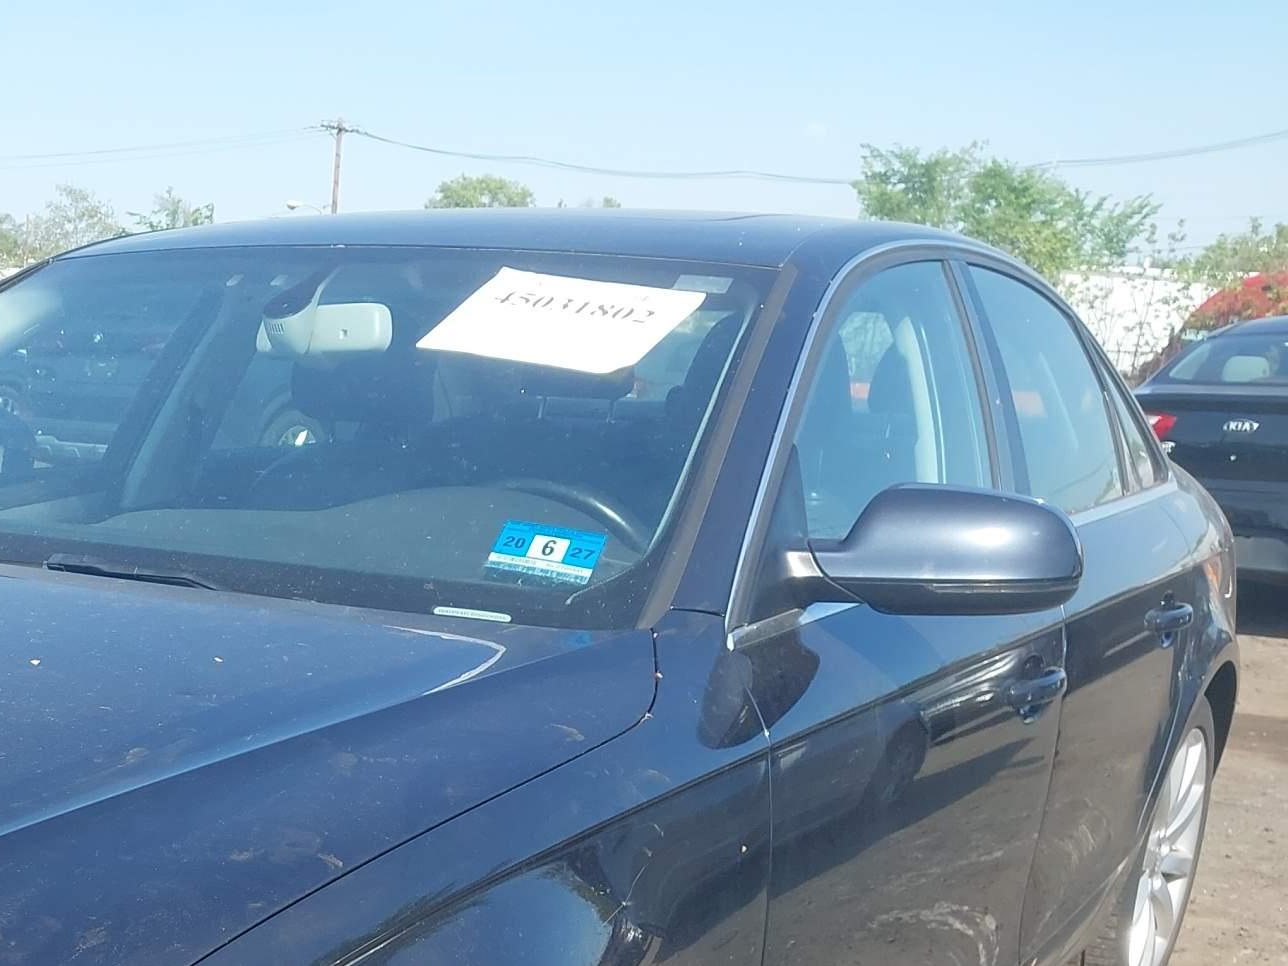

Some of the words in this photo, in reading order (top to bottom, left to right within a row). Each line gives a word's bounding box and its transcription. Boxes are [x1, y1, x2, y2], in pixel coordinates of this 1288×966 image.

[495, 291, 656, 324] 45031802
[503, 535, 527, 549] 20
[541, 539, 557, 557] 6
[569, 546, 596, 560] 27
